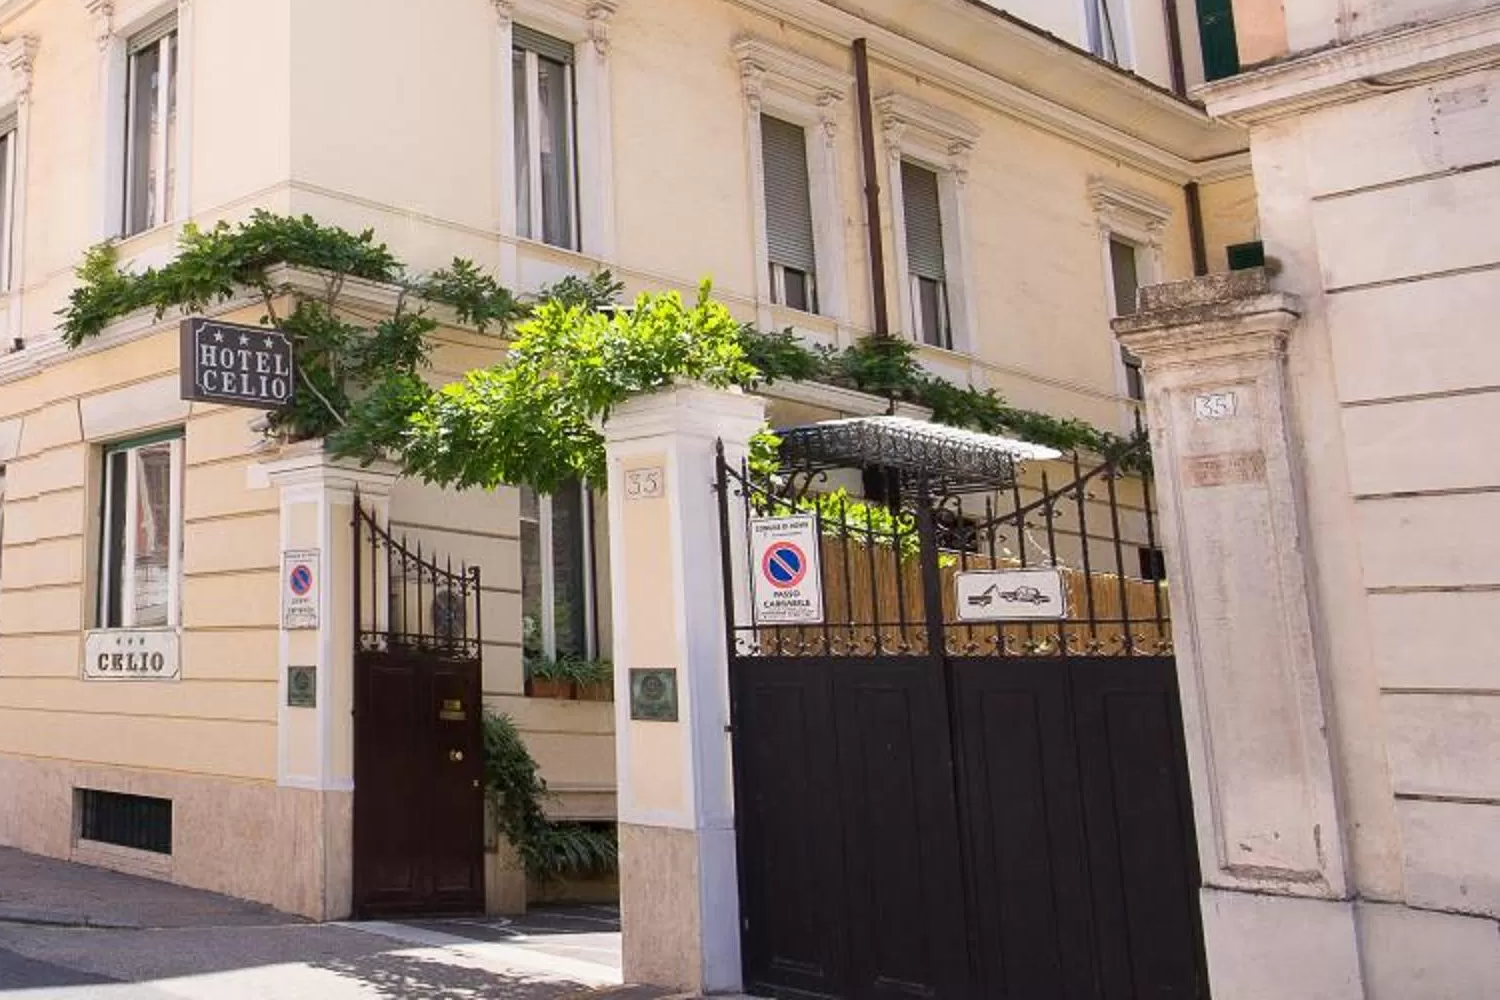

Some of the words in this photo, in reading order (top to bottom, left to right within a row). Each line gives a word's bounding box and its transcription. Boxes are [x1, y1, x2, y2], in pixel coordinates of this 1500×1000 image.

[200, 344, 289, 377] HOTEL
[203, 369, 286, 399] CELIO
[1199, 394, 1229, 417] 35
[628, 472, 658, 495] 35
[97, 651, 165, 673] CELIO
